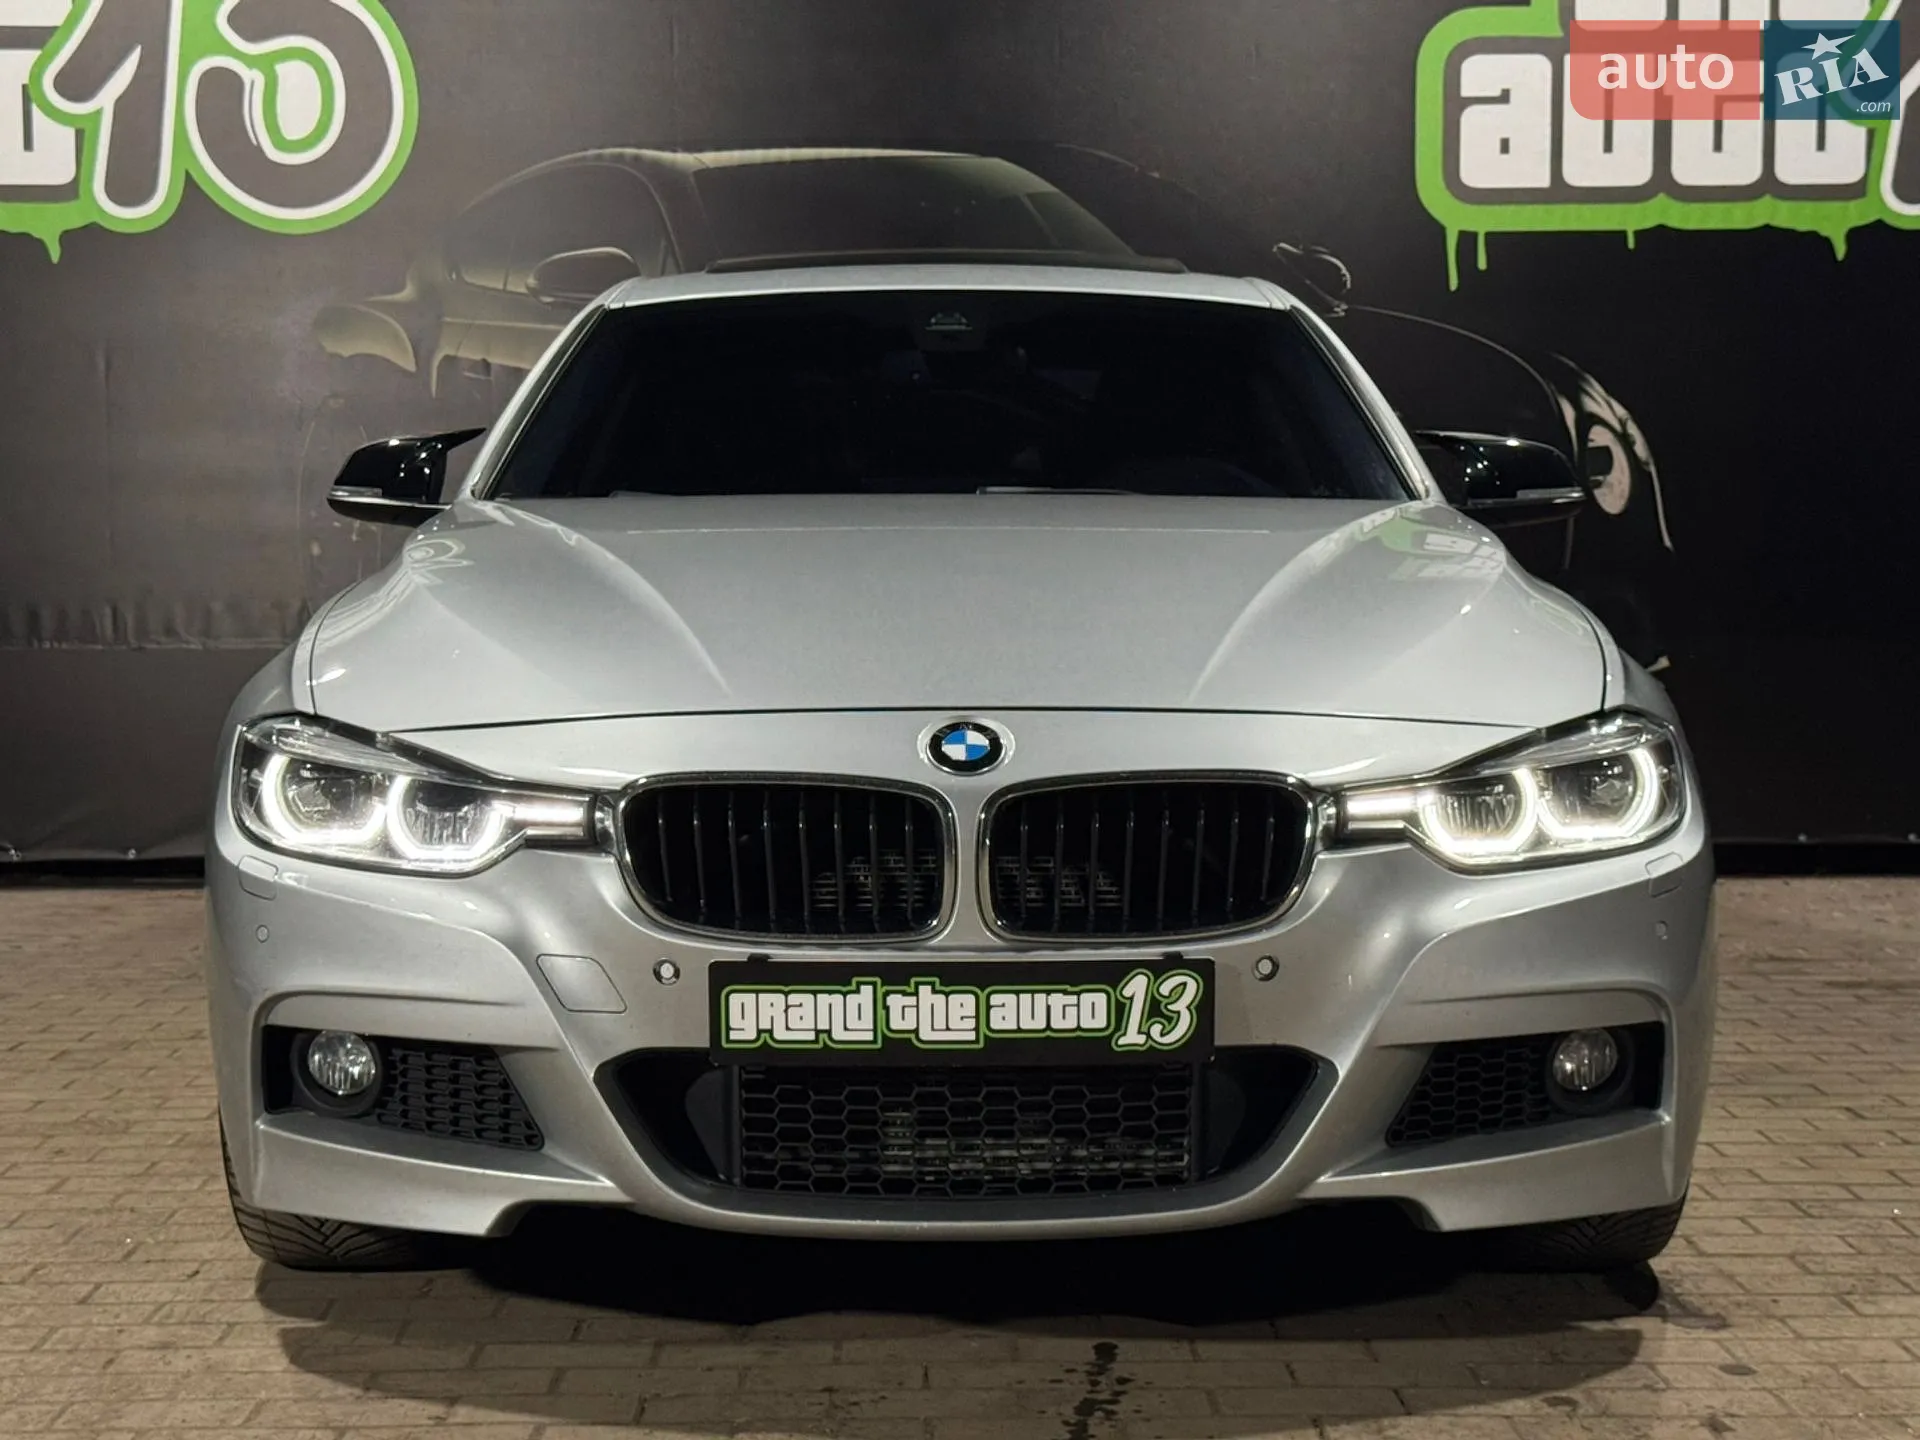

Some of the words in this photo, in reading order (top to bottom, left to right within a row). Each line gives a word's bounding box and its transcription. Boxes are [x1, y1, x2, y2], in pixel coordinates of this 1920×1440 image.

[886, 984, 977, 1041] the
[989, 991, 1108, 1031] auto
[1116, 973, 1198, 1047] 13
